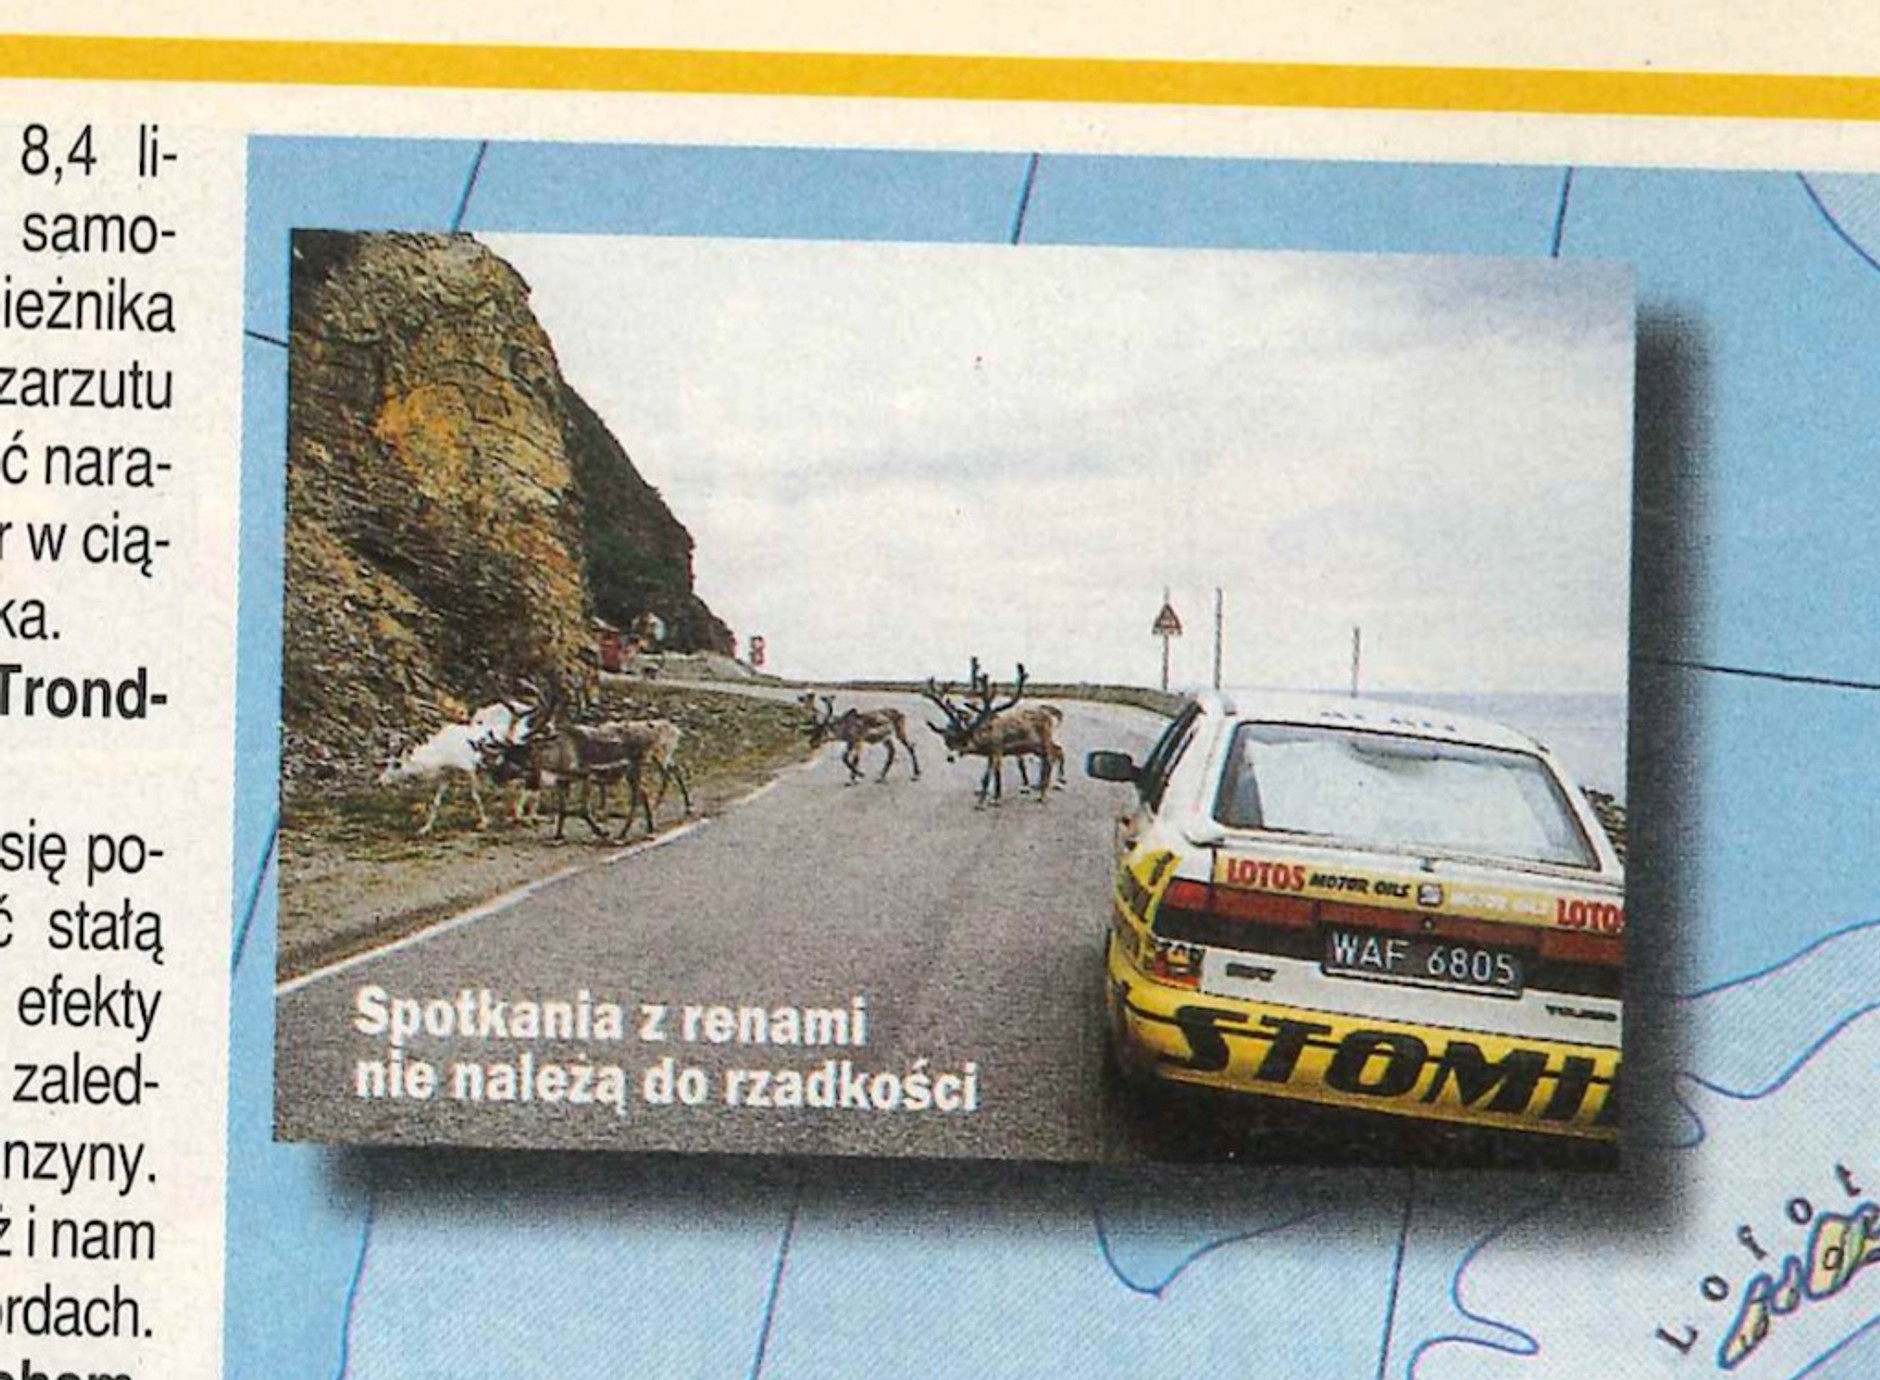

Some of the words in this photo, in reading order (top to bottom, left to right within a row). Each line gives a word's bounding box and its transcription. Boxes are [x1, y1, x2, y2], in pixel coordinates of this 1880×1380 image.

[22, 123, 97, 185] 8,4
[139, 124, 178, 178] li-
[22, 213, 176, 256] samo-
[4, 274, 175, 333] ieżnika
[0, 359, 173, 410] zarzutu
[45, 446, 172, 488] nara-
[26, 522, 67, 562] w
[82, 511, 170, 579] cią-
[0, 663, 168, 721] Trond-
[0, 818, 67, 886] się
[87, 833, 164, 888] po-
[1226, 857, 1307, 892] LOTOS
[1309, 873, 1369, 895] MOTOR
[1373, 880, 1411, 898] OILS
[48, 897, 163, 966] stałą
[1331, 930, 1411, 969] WAF
[1426, 945, 1515, 985] 6805
[17, 973, 162, 1043] efekty
[353, 984, 624, 1047] Spotkania
[640, 1004, 668, 1042] z
[681, 996, 868, 1045] renami
[13, 1053, 159, 1106] zaled-
[356, 1048, 437, 1099] nie
[453, 1051, 627, 1115] należą
[643, 1056, 708, 1105] do
[725, 1057, 978, 1112] rzadkości
[4, 1140, 156, 1197] nzyny.
[28, 1204, 36, 1258] i
[51, 1218, 155, 1260] nam
[0, 1282, 153, 1340] rdach.
